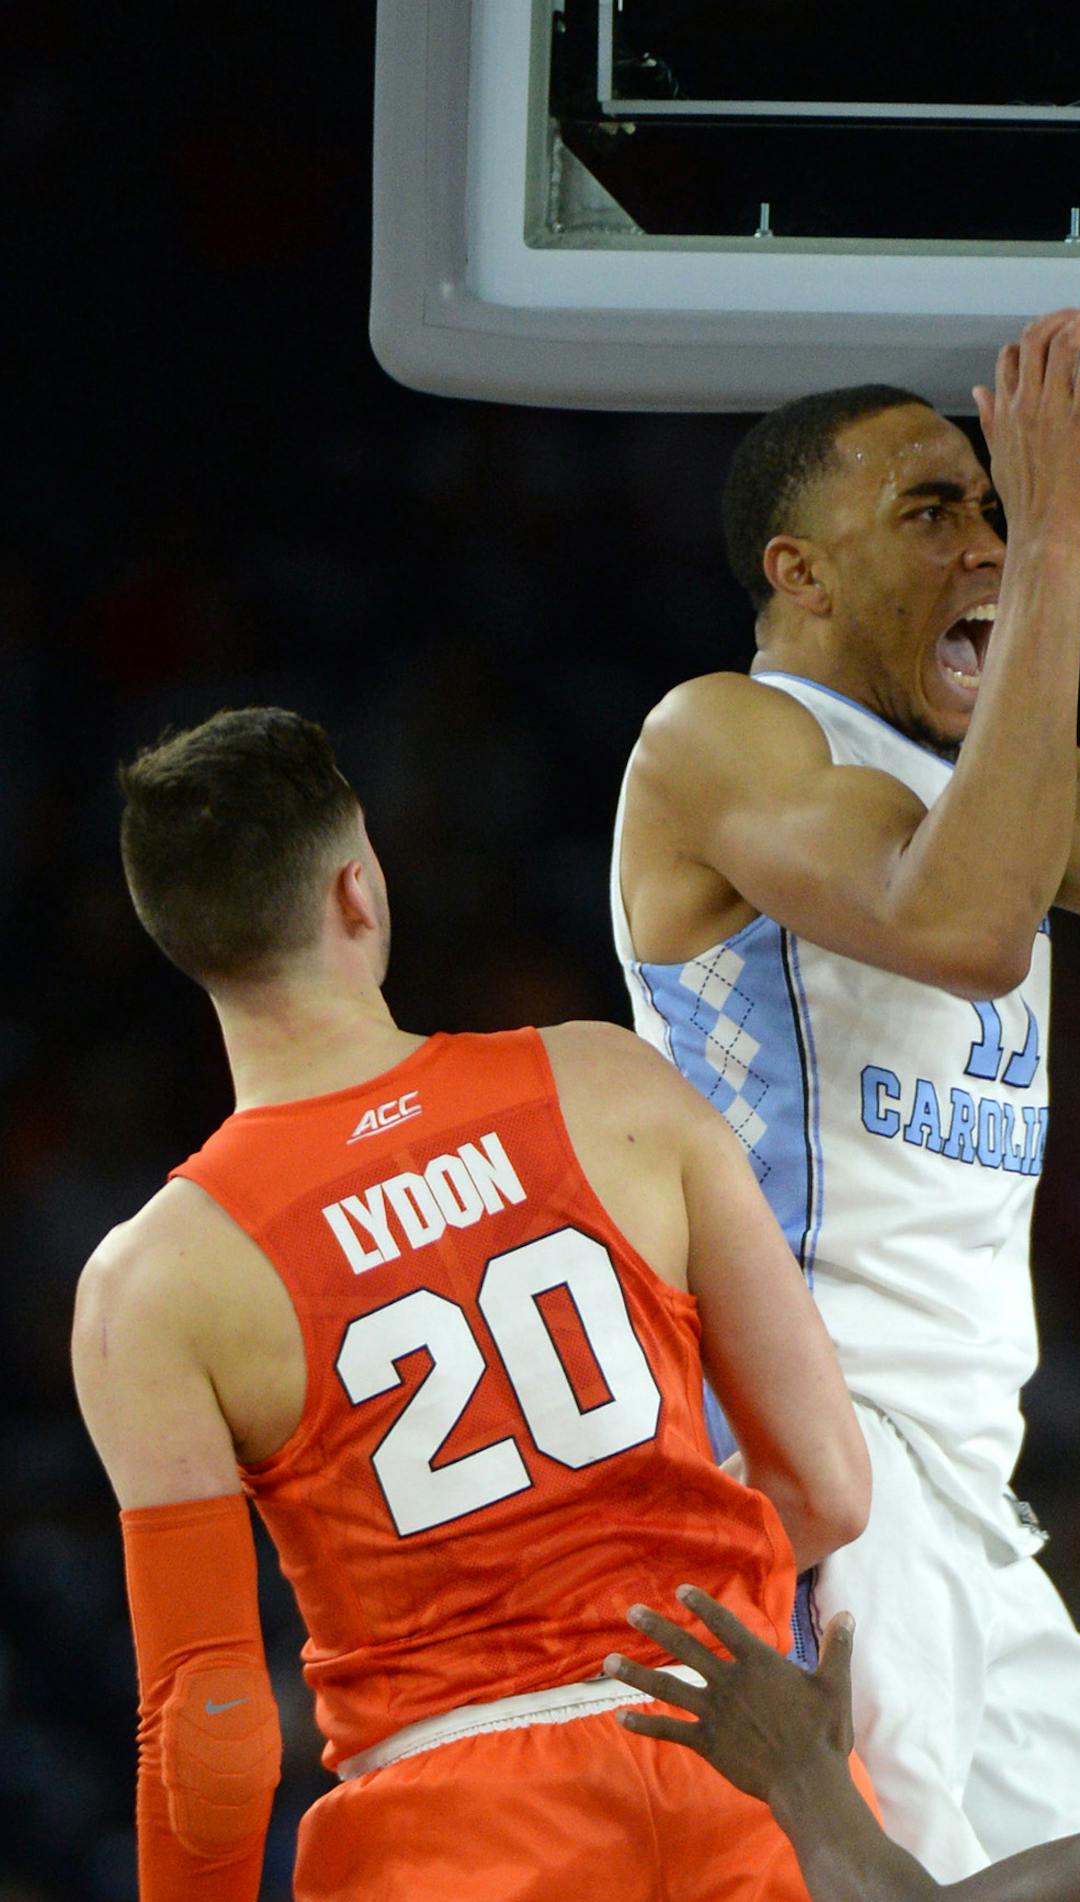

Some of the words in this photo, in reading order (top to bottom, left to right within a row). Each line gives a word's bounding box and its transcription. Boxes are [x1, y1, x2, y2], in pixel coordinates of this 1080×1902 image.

[349, 1090, 423, 1141] ACC
[321, 1131, 527, 1275] LYDON
[334, 1225, 662, 1540] 20
